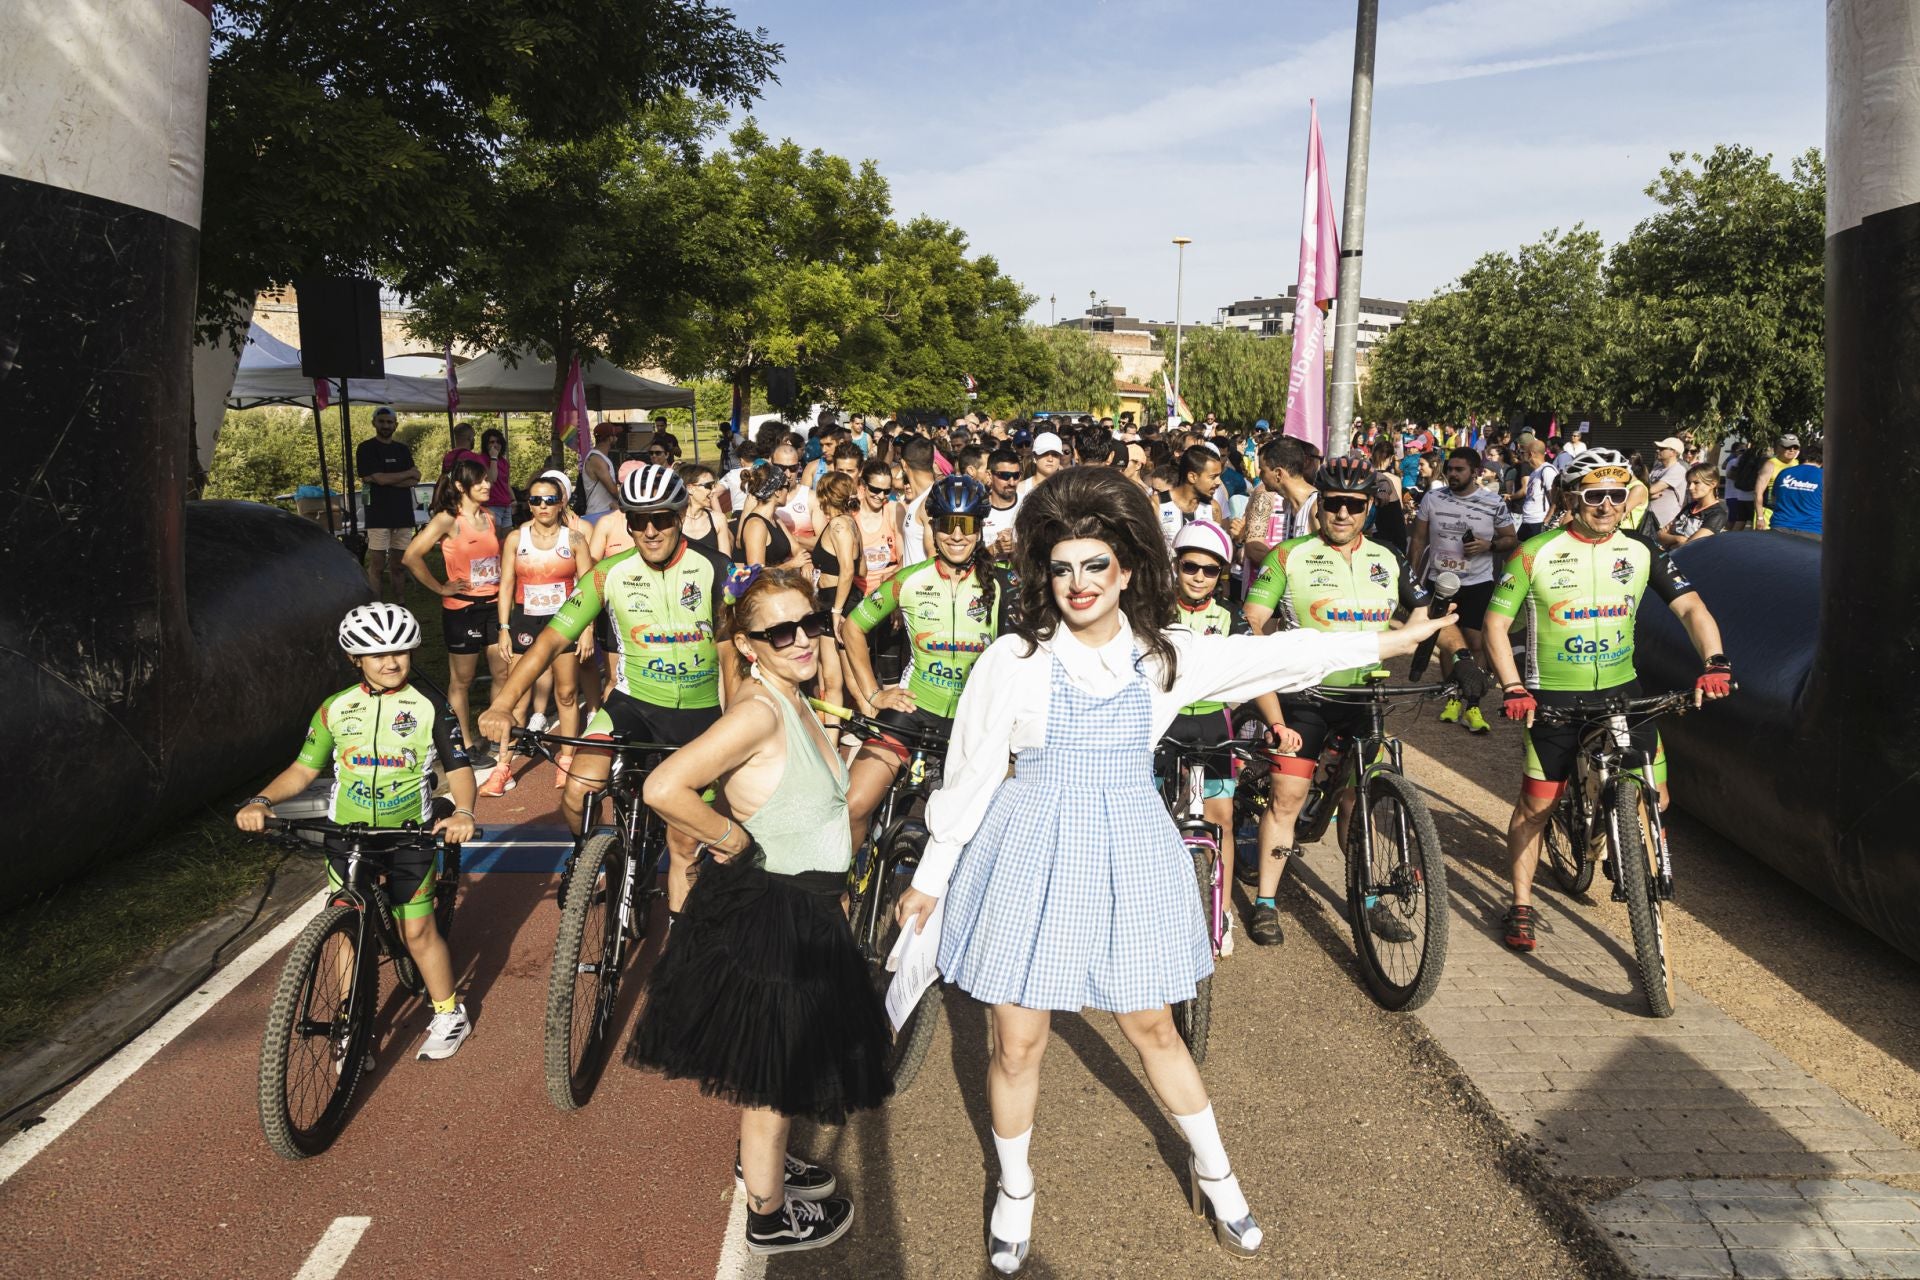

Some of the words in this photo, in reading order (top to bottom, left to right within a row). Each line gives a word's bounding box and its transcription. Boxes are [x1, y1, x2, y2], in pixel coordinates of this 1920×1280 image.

[1441, 559, 1465, 570] 301
[1564, 633, 1609, 654] Gas
[928, 660, 963, 680] Gas
[922, 672, 964, 688] Extrem
